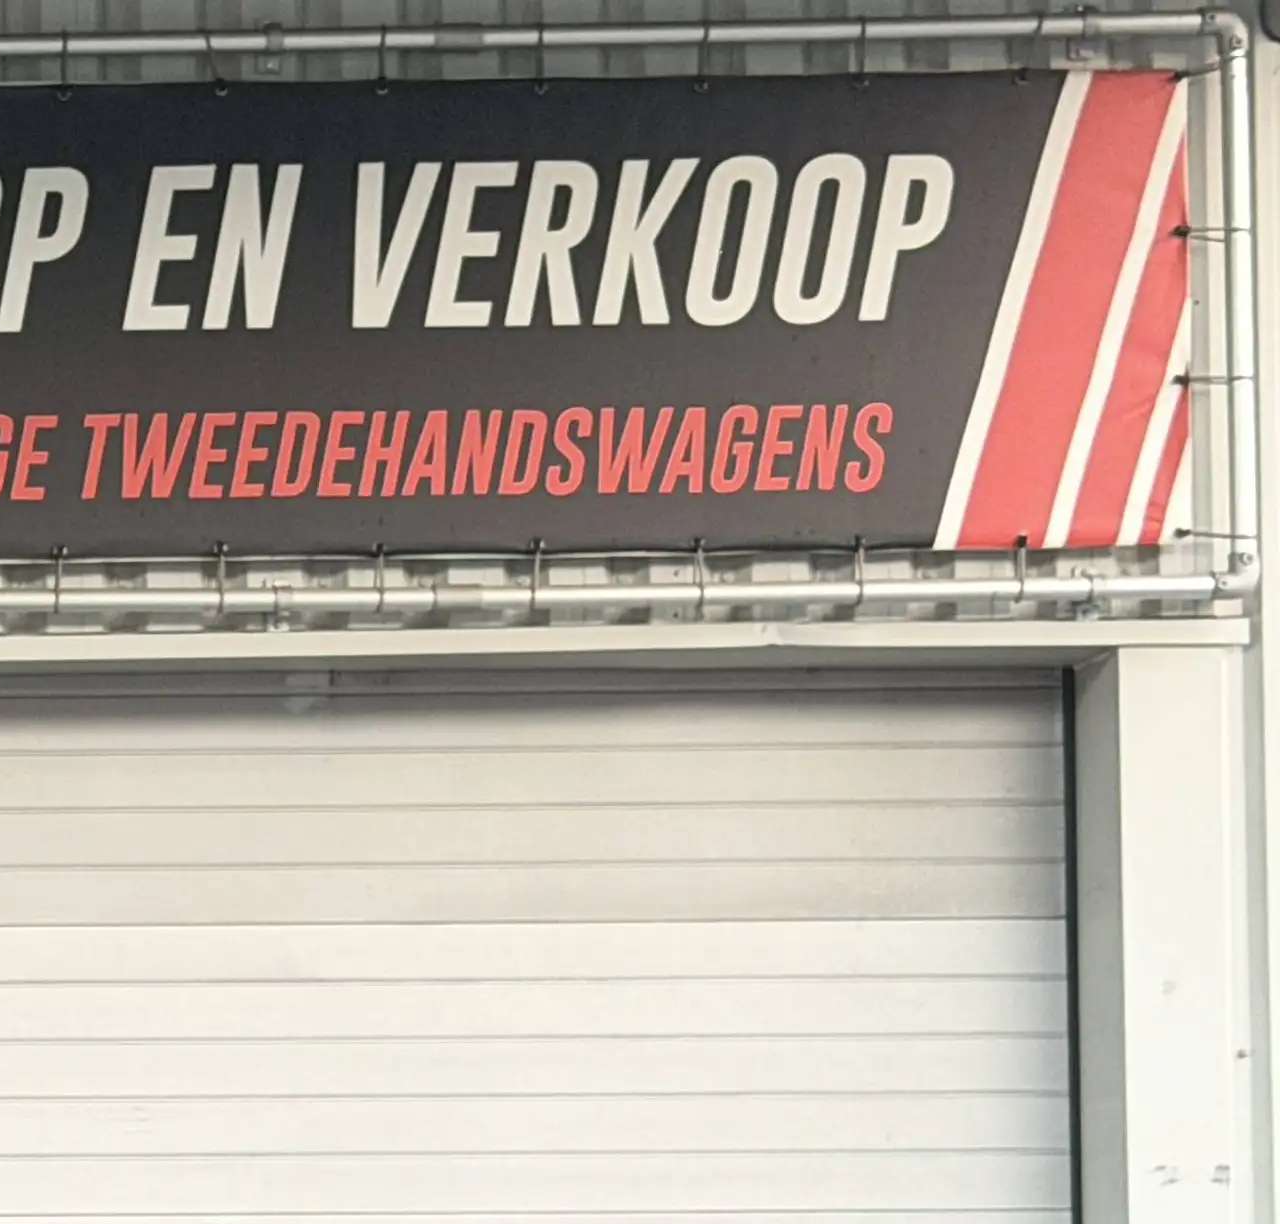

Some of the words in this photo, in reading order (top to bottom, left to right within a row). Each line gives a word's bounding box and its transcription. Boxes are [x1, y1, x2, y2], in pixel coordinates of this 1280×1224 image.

[122, 164, 302, 331] EN
[352, 153, 954, 328] VERKOOP
[81, 401, 895, 502] TWEEDEHANDSWAGENS
